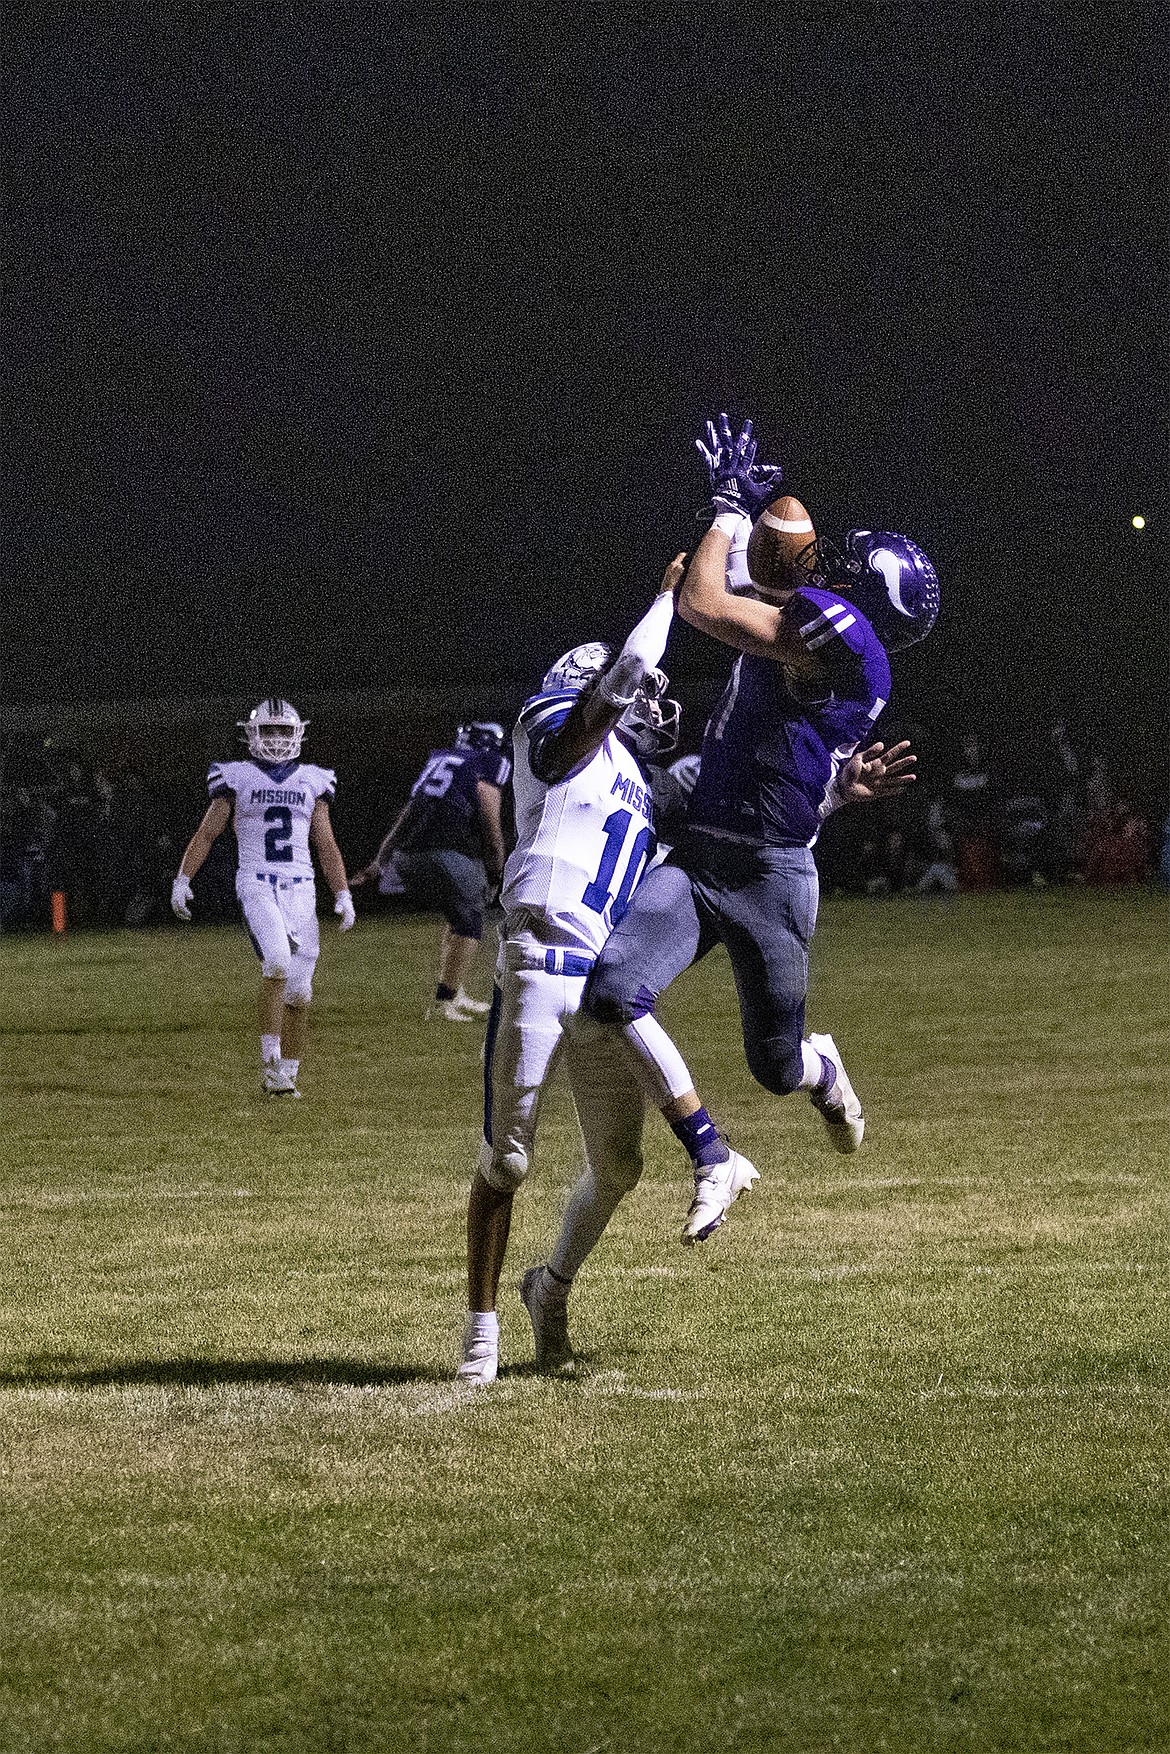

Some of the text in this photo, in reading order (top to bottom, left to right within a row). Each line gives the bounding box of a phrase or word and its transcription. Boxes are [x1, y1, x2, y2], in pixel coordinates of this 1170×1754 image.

[250, 789, 306, 805] MISSION
[264, 806, 293, 862] 2
[582, 808, 656, 925] 10
